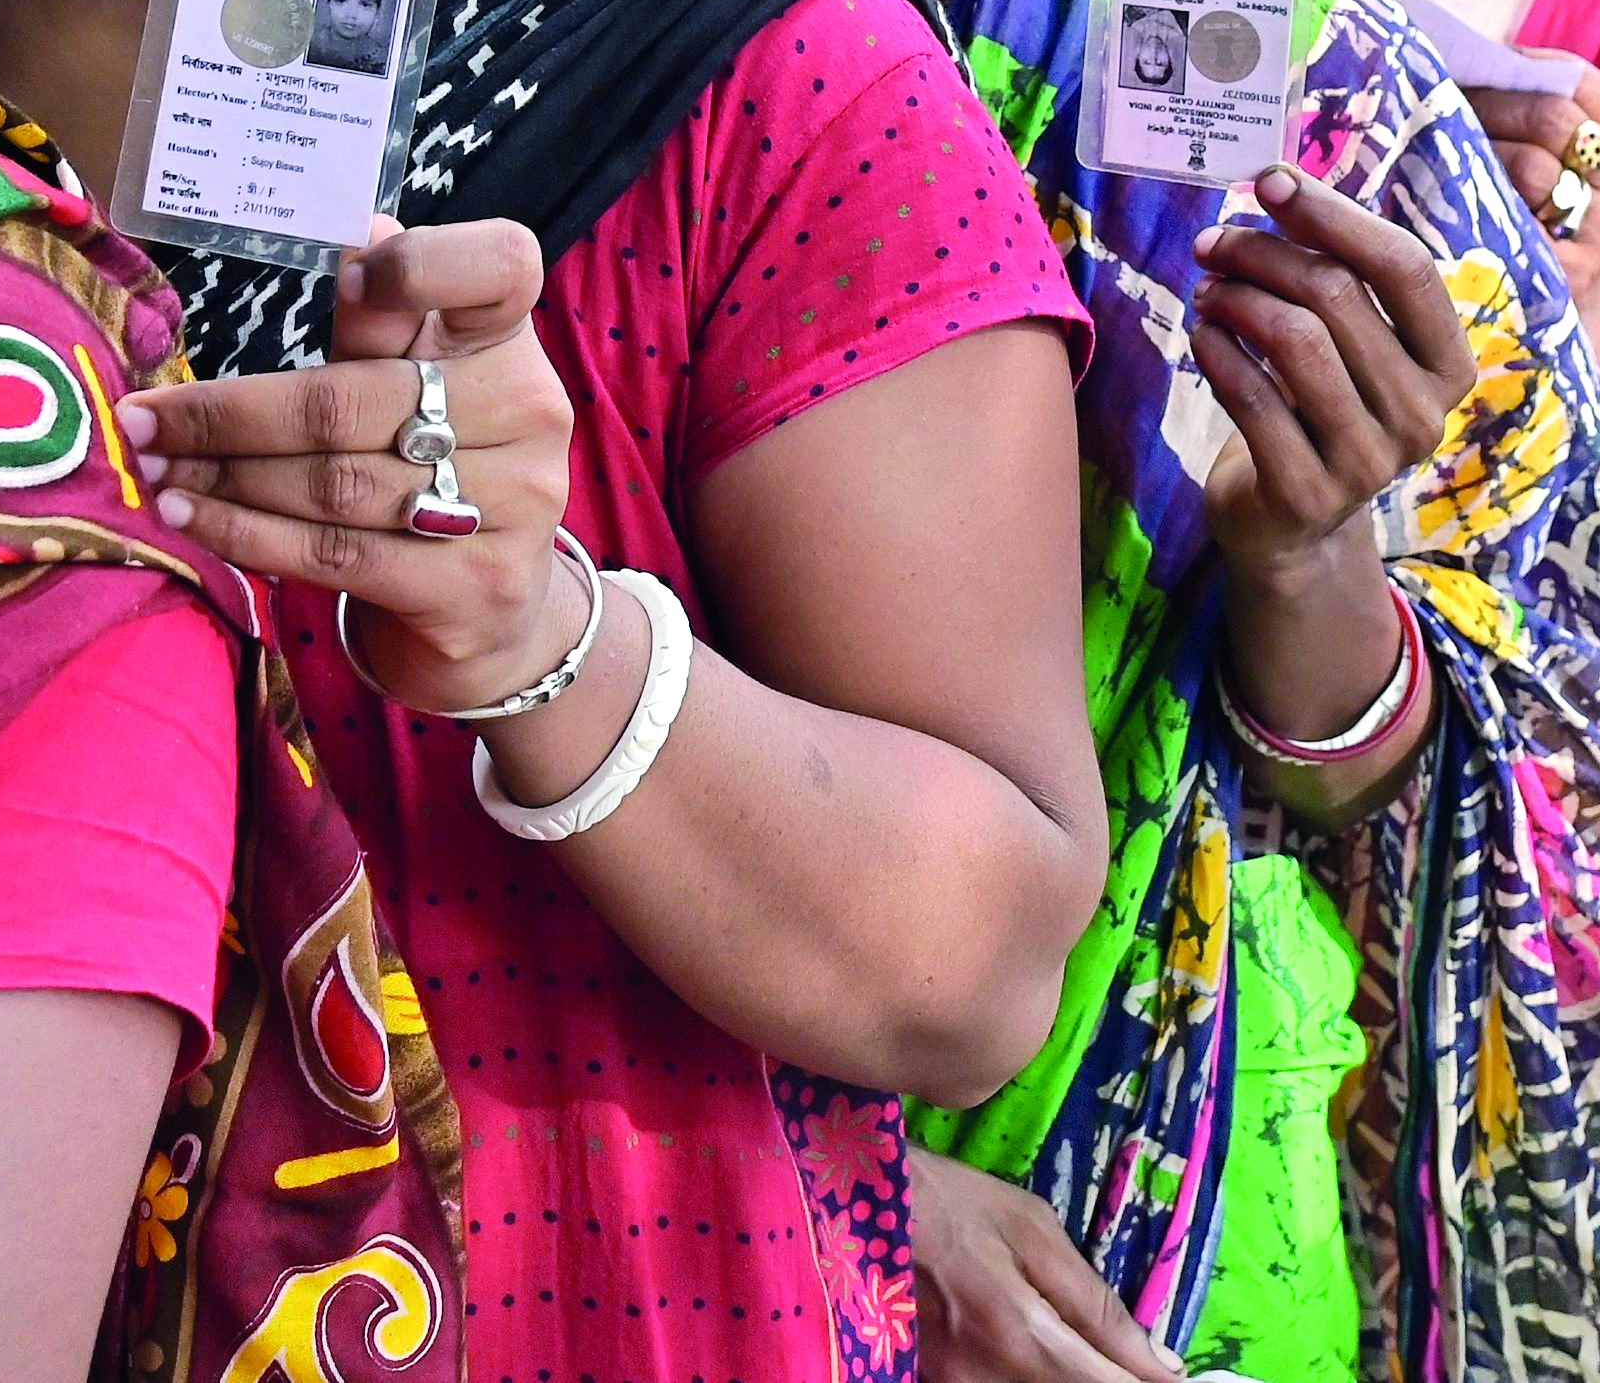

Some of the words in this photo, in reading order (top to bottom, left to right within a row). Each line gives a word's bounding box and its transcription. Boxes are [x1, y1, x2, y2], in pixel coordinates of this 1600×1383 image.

[177, 85, 218, 101] Elector's
[221, 93, 249, 106] Name
[309, 108, 338, 121] Biswas
[1129, 101, 1152, 111] INDIA
[1168, 96, 1193, 106] CARD
[1195, 99, 1236, 111] IDENTITY
[1155, 105, 1167, 113] OF
[1168, 106, 1226, 120] COMMISSION
[1227, 114, 1273, 126] ELECTION
[167, 142, 217, 159] Husband's
[250, 155, 274, 170] Sujoy
[276, 160, 304, 173] Biswas
[268, 187, 277, 198] F
[158, 200, 180, 212] Date
[182, 203, 193, 213] of
[194, 207, 219, 218] Birth
[243, 201, 296, 219] 21/11/1997
